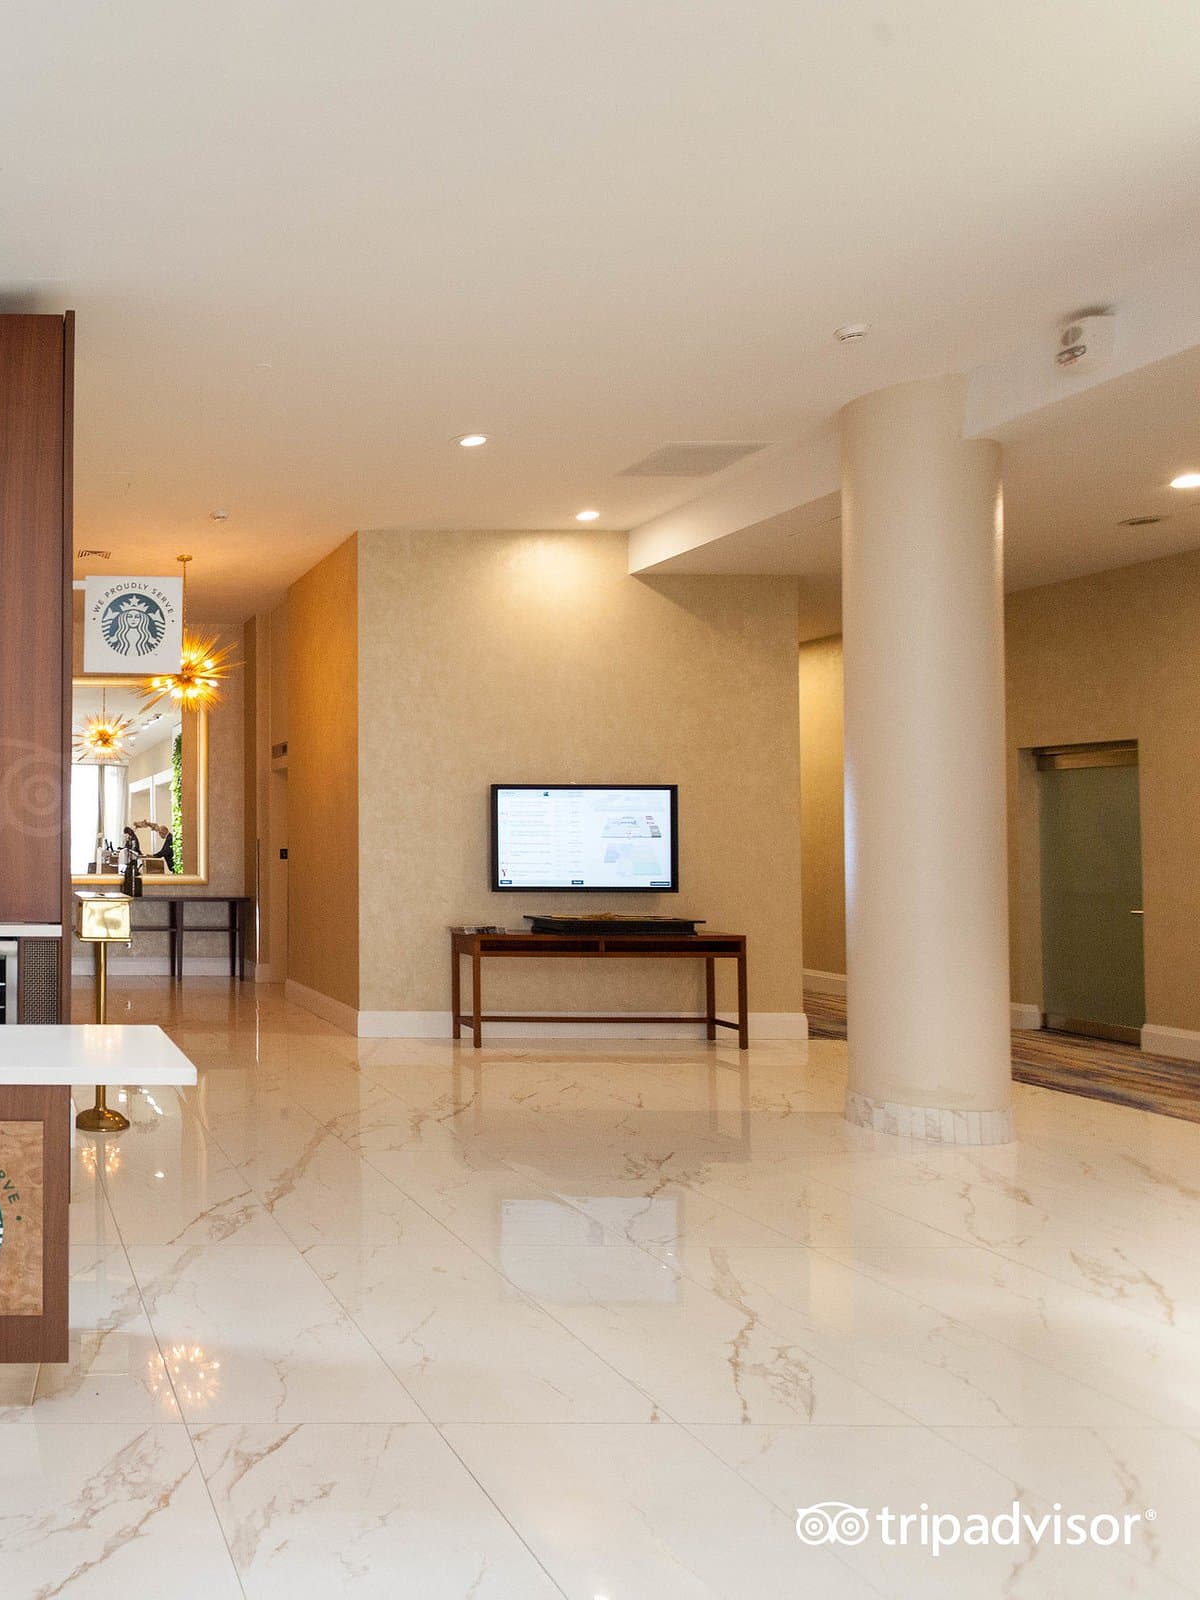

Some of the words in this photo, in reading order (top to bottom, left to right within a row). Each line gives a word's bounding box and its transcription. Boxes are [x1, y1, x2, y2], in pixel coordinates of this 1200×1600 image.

[94, 600, 104, 613] WE
[105, 582, 149, 597] PROUDLY
[152, 589, 174, 613] SERVE
